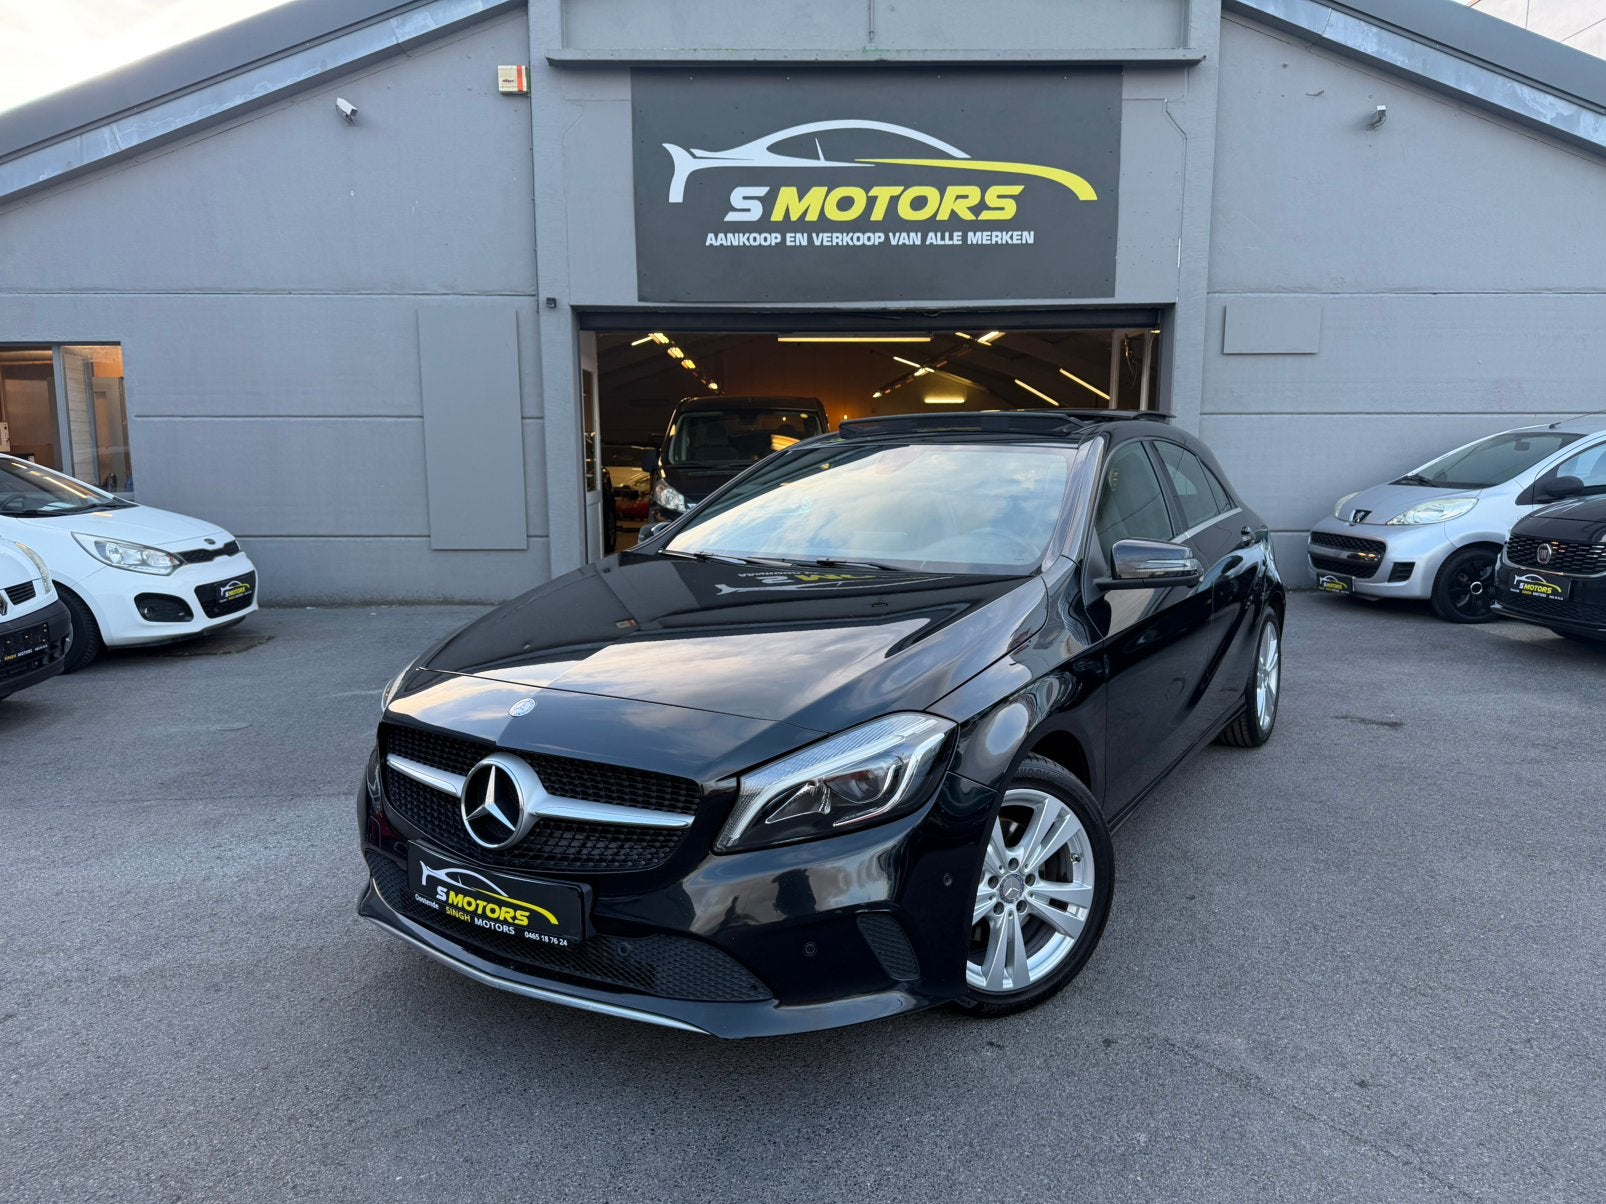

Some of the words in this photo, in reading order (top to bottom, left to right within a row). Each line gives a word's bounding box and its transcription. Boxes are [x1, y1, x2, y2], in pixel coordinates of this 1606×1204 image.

[724, 186, 770, 221] S
[770, 185, 1025, 221] MOTORS
[705, 232, 781, 246] AANKOOP
[786, 232, 808, 246] EN
[812, 232, 885, 246] VERKOOP
[889, 231, 922, 245] VAN
[926, 231, 962, 245] ALLE
[967, 230, 1035, 245] MERKEN
[1524, 583, 1553, 594] MOTORS
[436, 886, 448, 902] S
[448, 890, 530, 926] MOTORS
[445, 906, 471, 923] SINGH
[475, 916, 516, 935] MOTORS
[524, 930, 540, 941] 0465
[541, 934, 549, 943] 18
[550, 936, 559, 945] 76
[559, 938, 568, 947] 24
